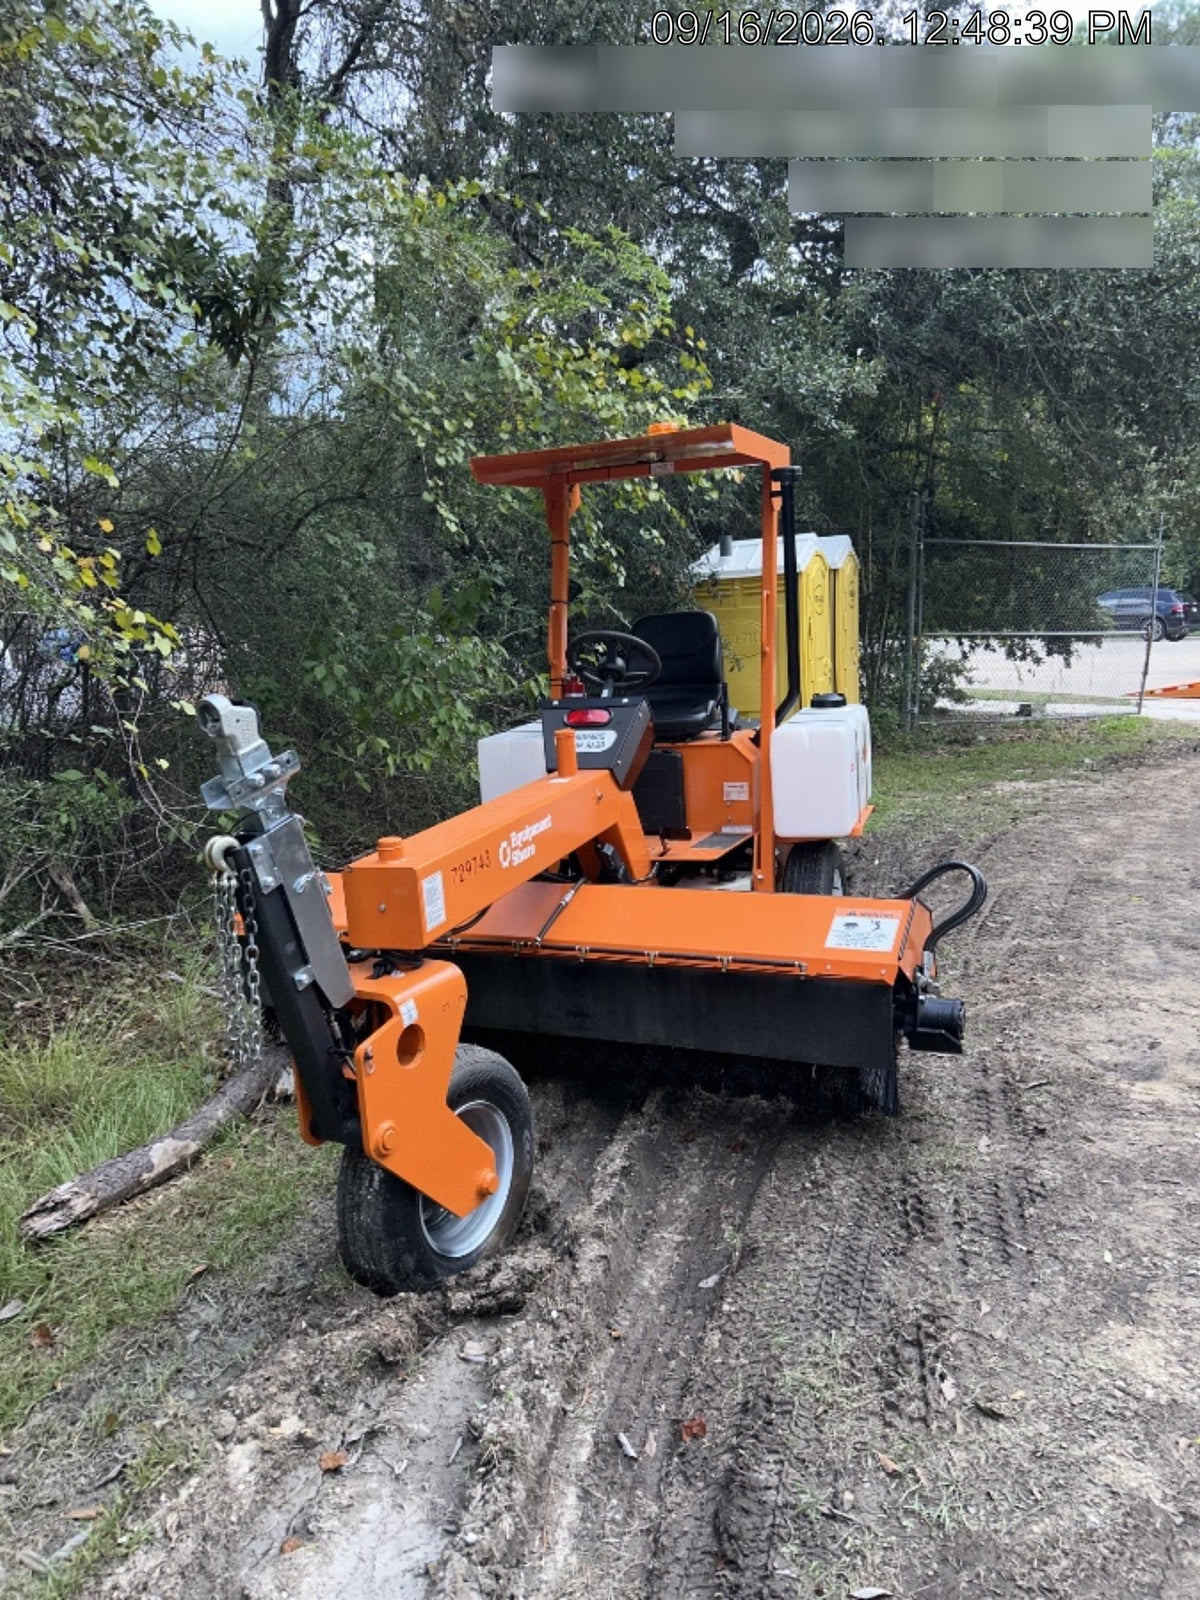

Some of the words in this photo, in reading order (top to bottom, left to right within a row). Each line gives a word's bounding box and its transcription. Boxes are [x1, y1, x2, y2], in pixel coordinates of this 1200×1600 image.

[510, 813, 552, 848] Equipment
[451, 849, 491, 885] 729743
[511, 843, 536, 867] Share
